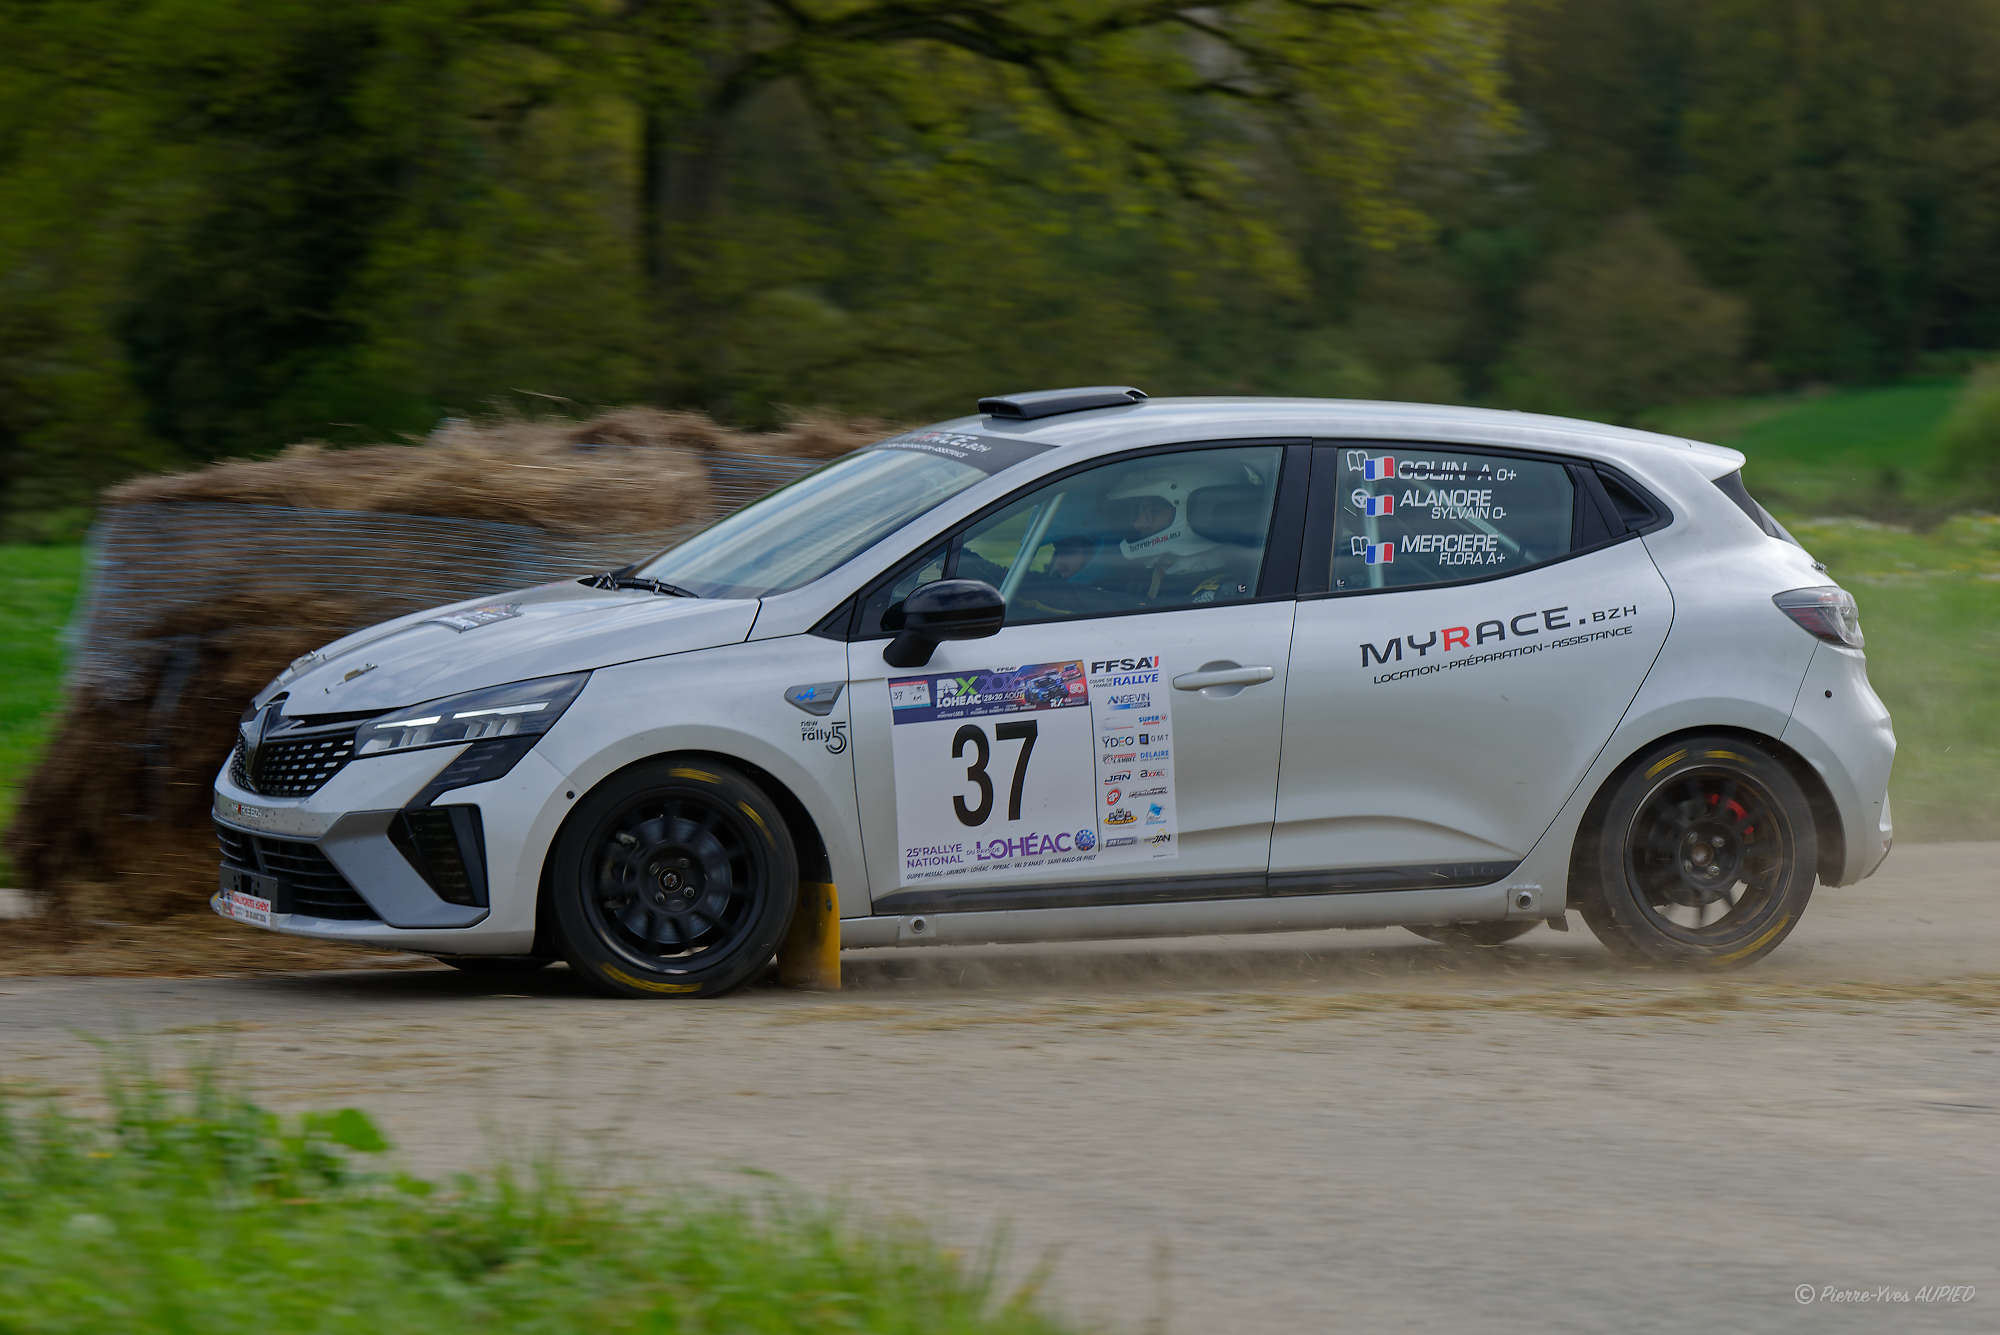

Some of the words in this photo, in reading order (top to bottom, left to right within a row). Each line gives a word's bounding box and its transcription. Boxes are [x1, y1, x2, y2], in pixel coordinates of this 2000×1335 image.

[1400, 489, 1492, 507] ALANORE
[1431, 506, 1490, 520] SYLVAIN
[1401, 534, 1499, 553] MERCIERE
[1439, 552, 1483, 566] FLORA
[1486, 552, 1506, 566] A+
[1091, 657, 1153, 674] FFSA
[1113, 673, 1159, 687] RALLYE
[951, 720, 1039, 827] 37
[923, 843, 963, 856] RALLYE
[976, 832, 1072, 861] LOHÉAC
[907, 855, 964, 868] NATIONAL
